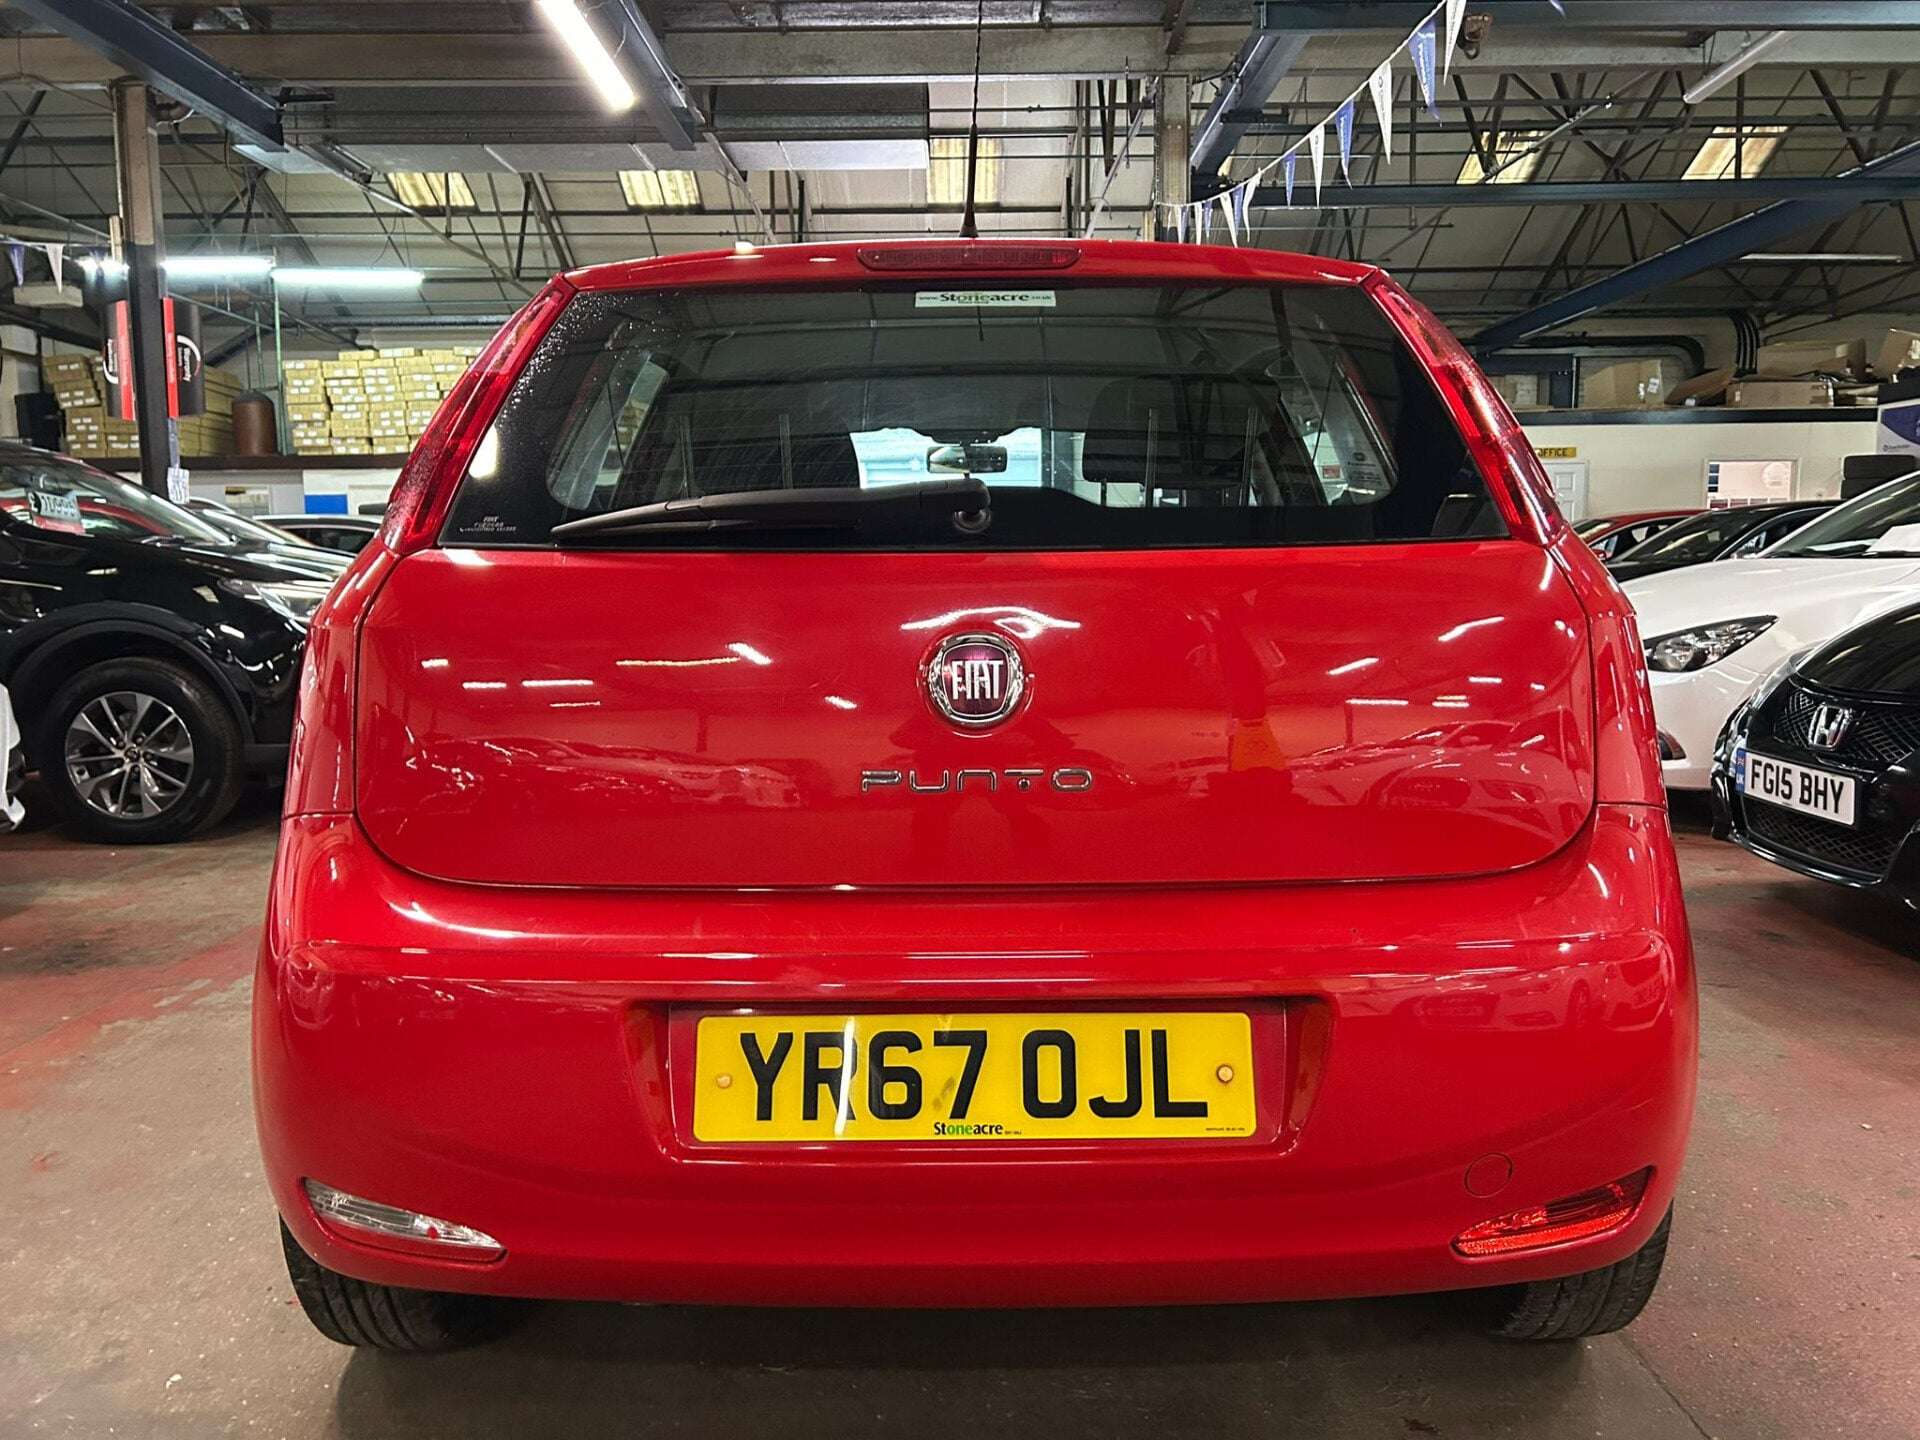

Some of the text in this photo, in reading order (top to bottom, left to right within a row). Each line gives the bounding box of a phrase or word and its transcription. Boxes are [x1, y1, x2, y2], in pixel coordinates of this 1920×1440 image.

[940, 292, 1029, 302] Stoneacre
[951, 659, 1004, 700] FIAT
[861, 767, 1093, 793] PUNTO
[1751, 758, 1844, 814] FG15 BHY
[740, 1028, 1208, 1122] YR67 OJL
[934, 1122, 1003, 1135] Stoneacre
